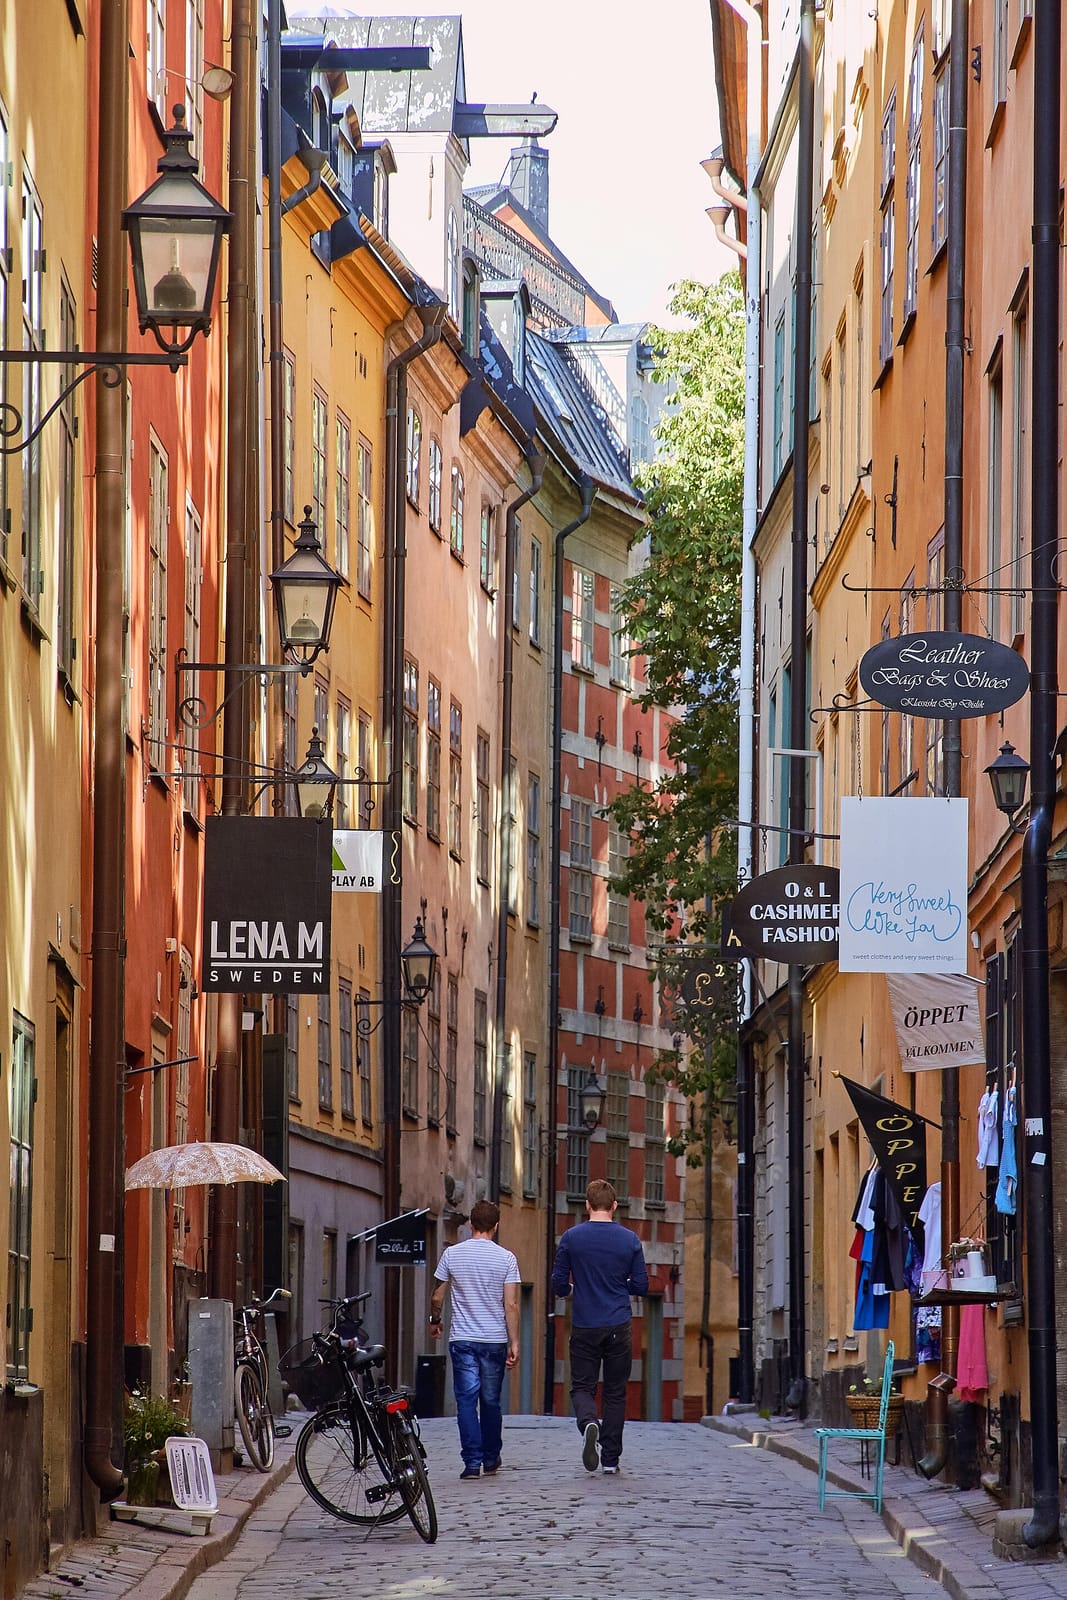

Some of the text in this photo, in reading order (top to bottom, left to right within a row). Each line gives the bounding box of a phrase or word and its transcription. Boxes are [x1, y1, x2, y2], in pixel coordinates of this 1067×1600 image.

[899, 639, 986, 665] Leather
[872, 666, 1011, 692] Bags & Shoes
[360, 876, 375, 887] AB
[784, 882, 832, 898] O & L
[869, 881, 953, 916] Very Sweet
[210, 920, 323, 960] LENA M
[905, 916, 939, 942] You
[210, 970, 323, 983] SWEDEN
[904, 1004, 969, 1028] ÖPPET
[905, 1040, 976, 1058] VÄLKOMMEN
